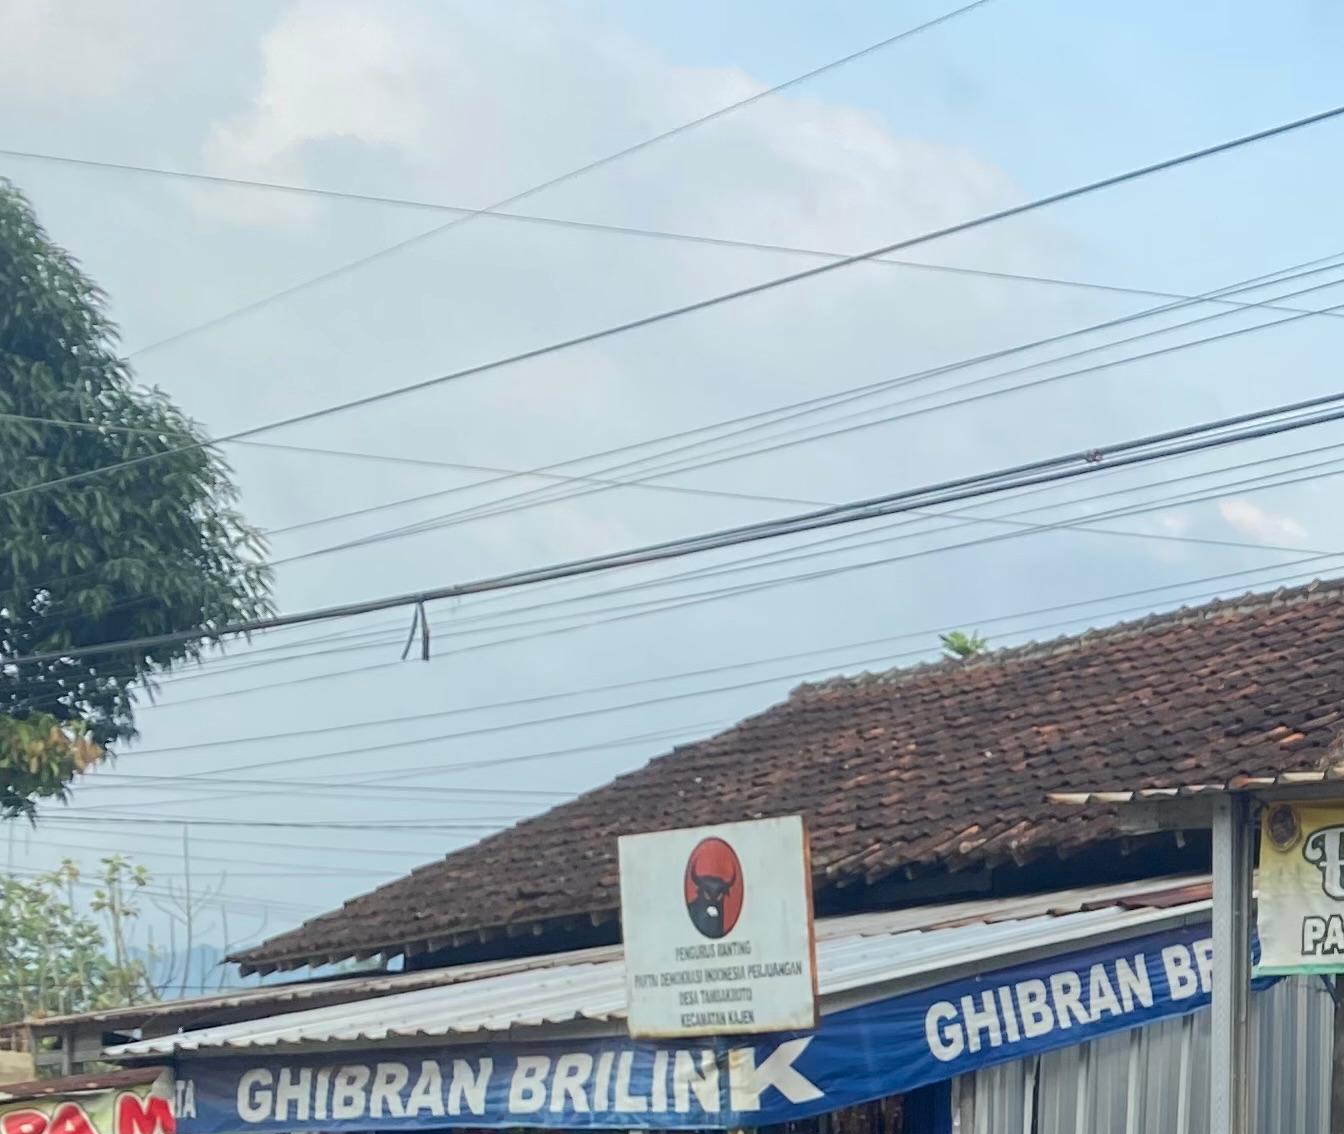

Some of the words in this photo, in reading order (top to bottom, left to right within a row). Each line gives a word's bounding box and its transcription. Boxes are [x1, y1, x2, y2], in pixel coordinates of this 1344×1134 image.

[704, 965, 747, 984] INDONESIA
[747, 960, 803, 979] PERJUANGAN
[678, 989, 700, 1006] DESA
[925, 952, 1155, 1063] GHIBRAN
[680, 1011, 727, 1028] KECAMATAN
[728, 1010, 755, 1026] KAJEN
[237, 1056, 493, 1124] GHIBRAN
[508, 1035, 826, 1114] BRILINK
